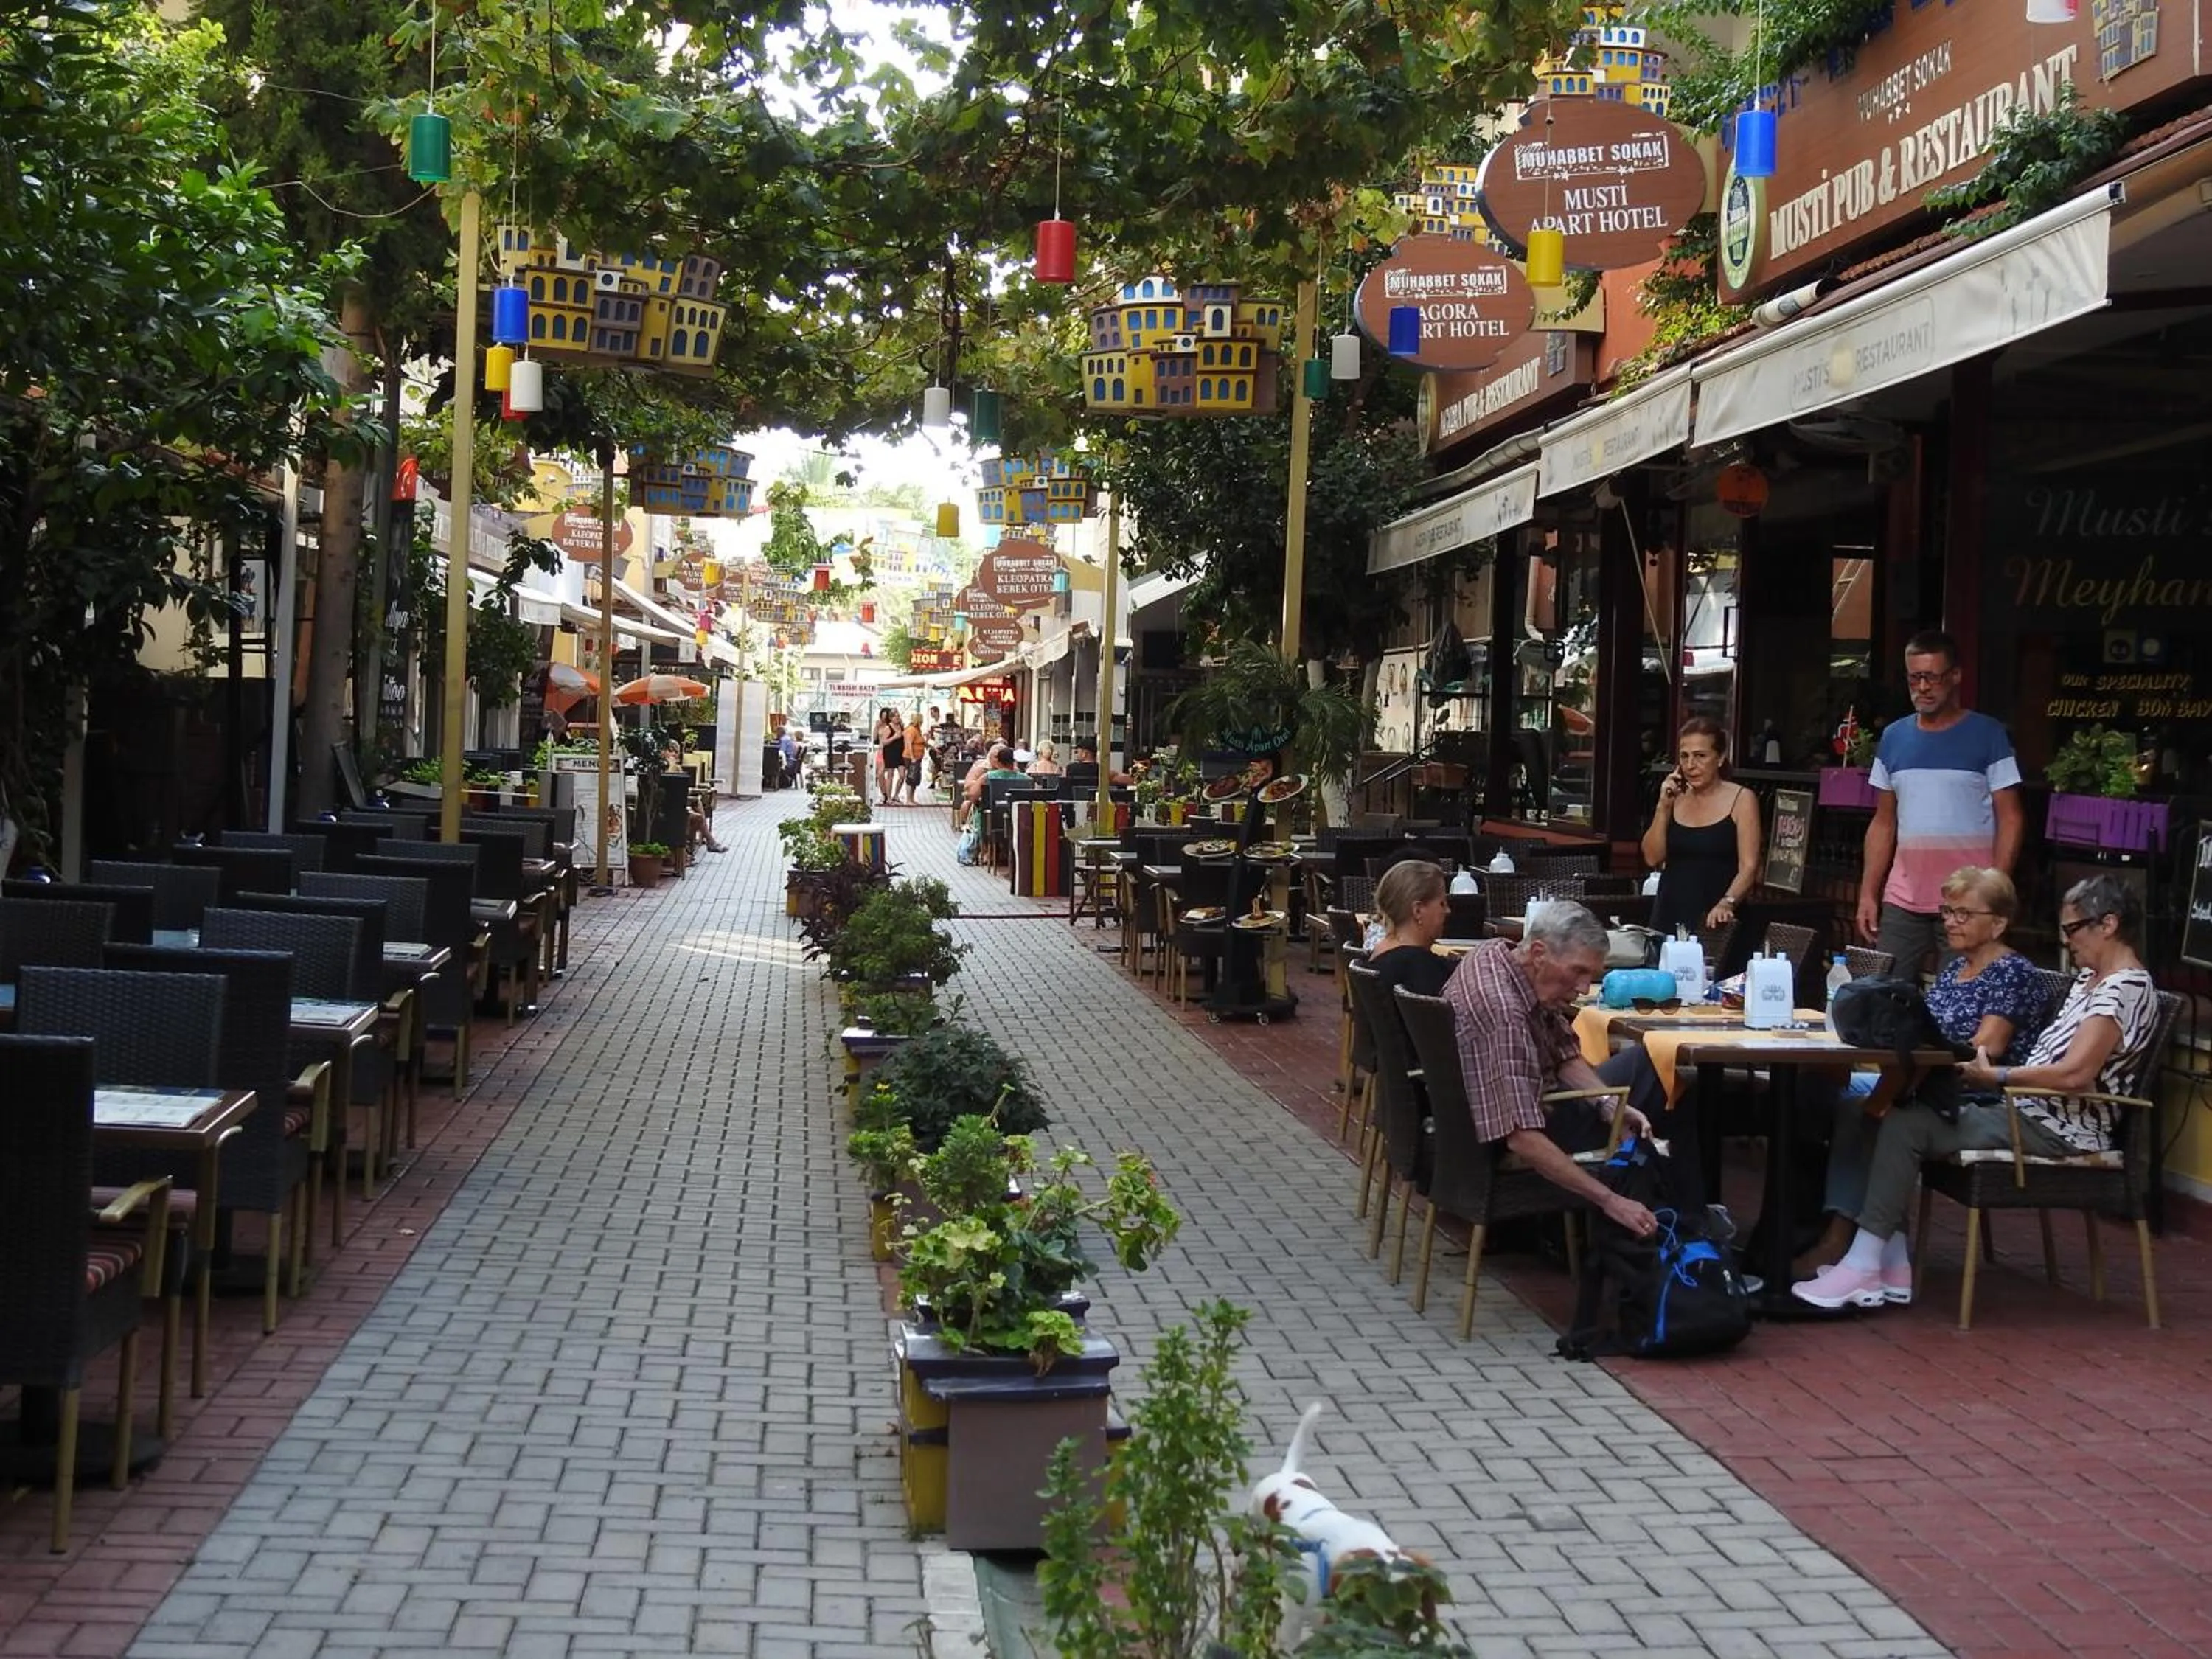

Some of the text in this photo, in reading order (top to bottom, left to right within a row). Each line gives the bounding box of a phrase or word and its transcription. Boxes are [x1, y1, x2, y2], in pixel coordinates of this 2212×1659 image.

[1857, 38, 1952, 124] MUHABBET SOKAK
[1833, 159, 1874, 226] PUB
[1878, 147, 1897, 206] &
[1899, 44, 2077, 195] RESTAURANT
[1522, 141, 1663, 169] MUHABBET SOKAK
[1531, 206, 1668, 236] APART HOTEL
[1389, 271, 1503, 290] MUHABBET SOKAK
[1450, 319, 1510, 338] HOTEL
[1855, 322, 1930, 375] RESTAURANT
[998, 574, 1054, 583] KLEOPATRA
[1030, 583, 1051, 593] OTE
[573, 759, 599, 768] MEN
